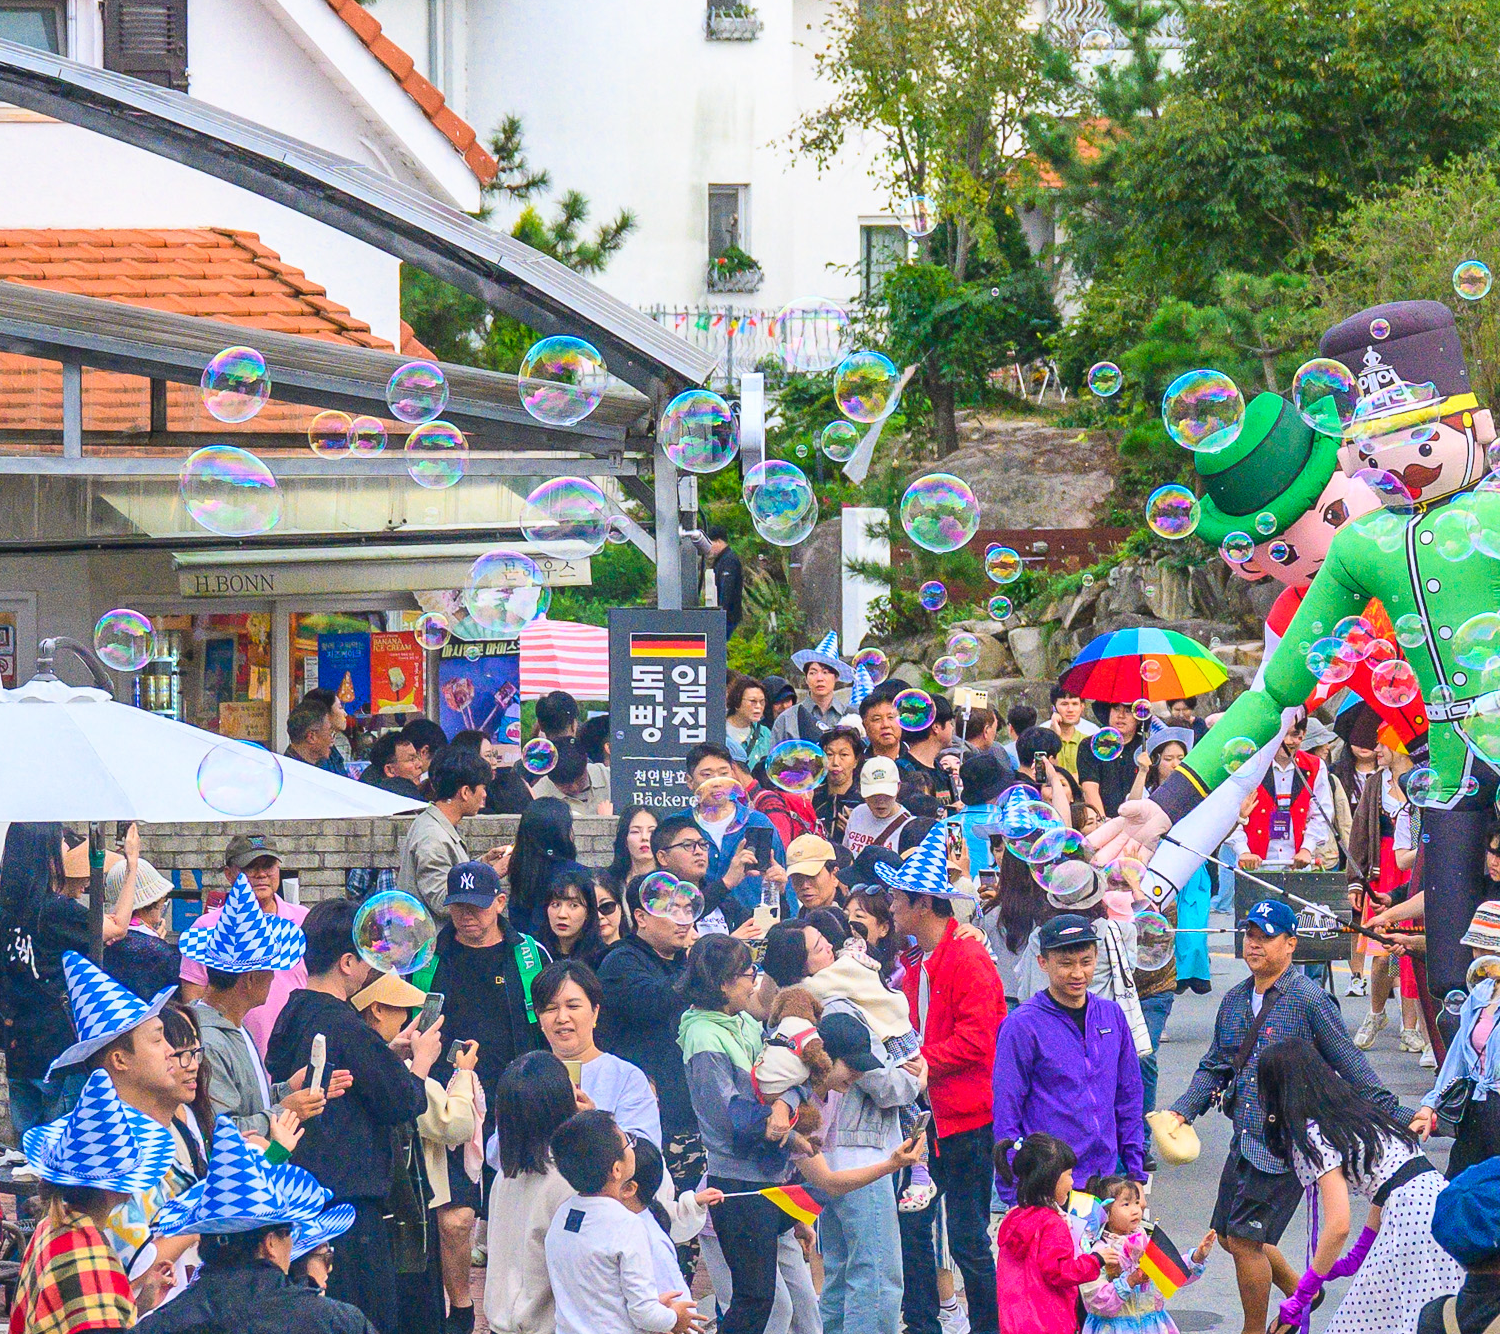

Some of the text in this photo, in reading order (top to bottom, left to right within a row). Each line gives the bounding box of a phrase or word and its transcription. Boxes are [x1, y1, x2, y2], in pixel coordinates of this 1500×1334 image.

[194, 573, 276, 595] H.BONN
[372, 636, 402, 647] BANANA
[387, 643, 412, 653] CREAM
[630, 664, 706, 703] 독일
[630, 704, 706, 744] 빵집
[632, 791, 698, 808] Bäckere
